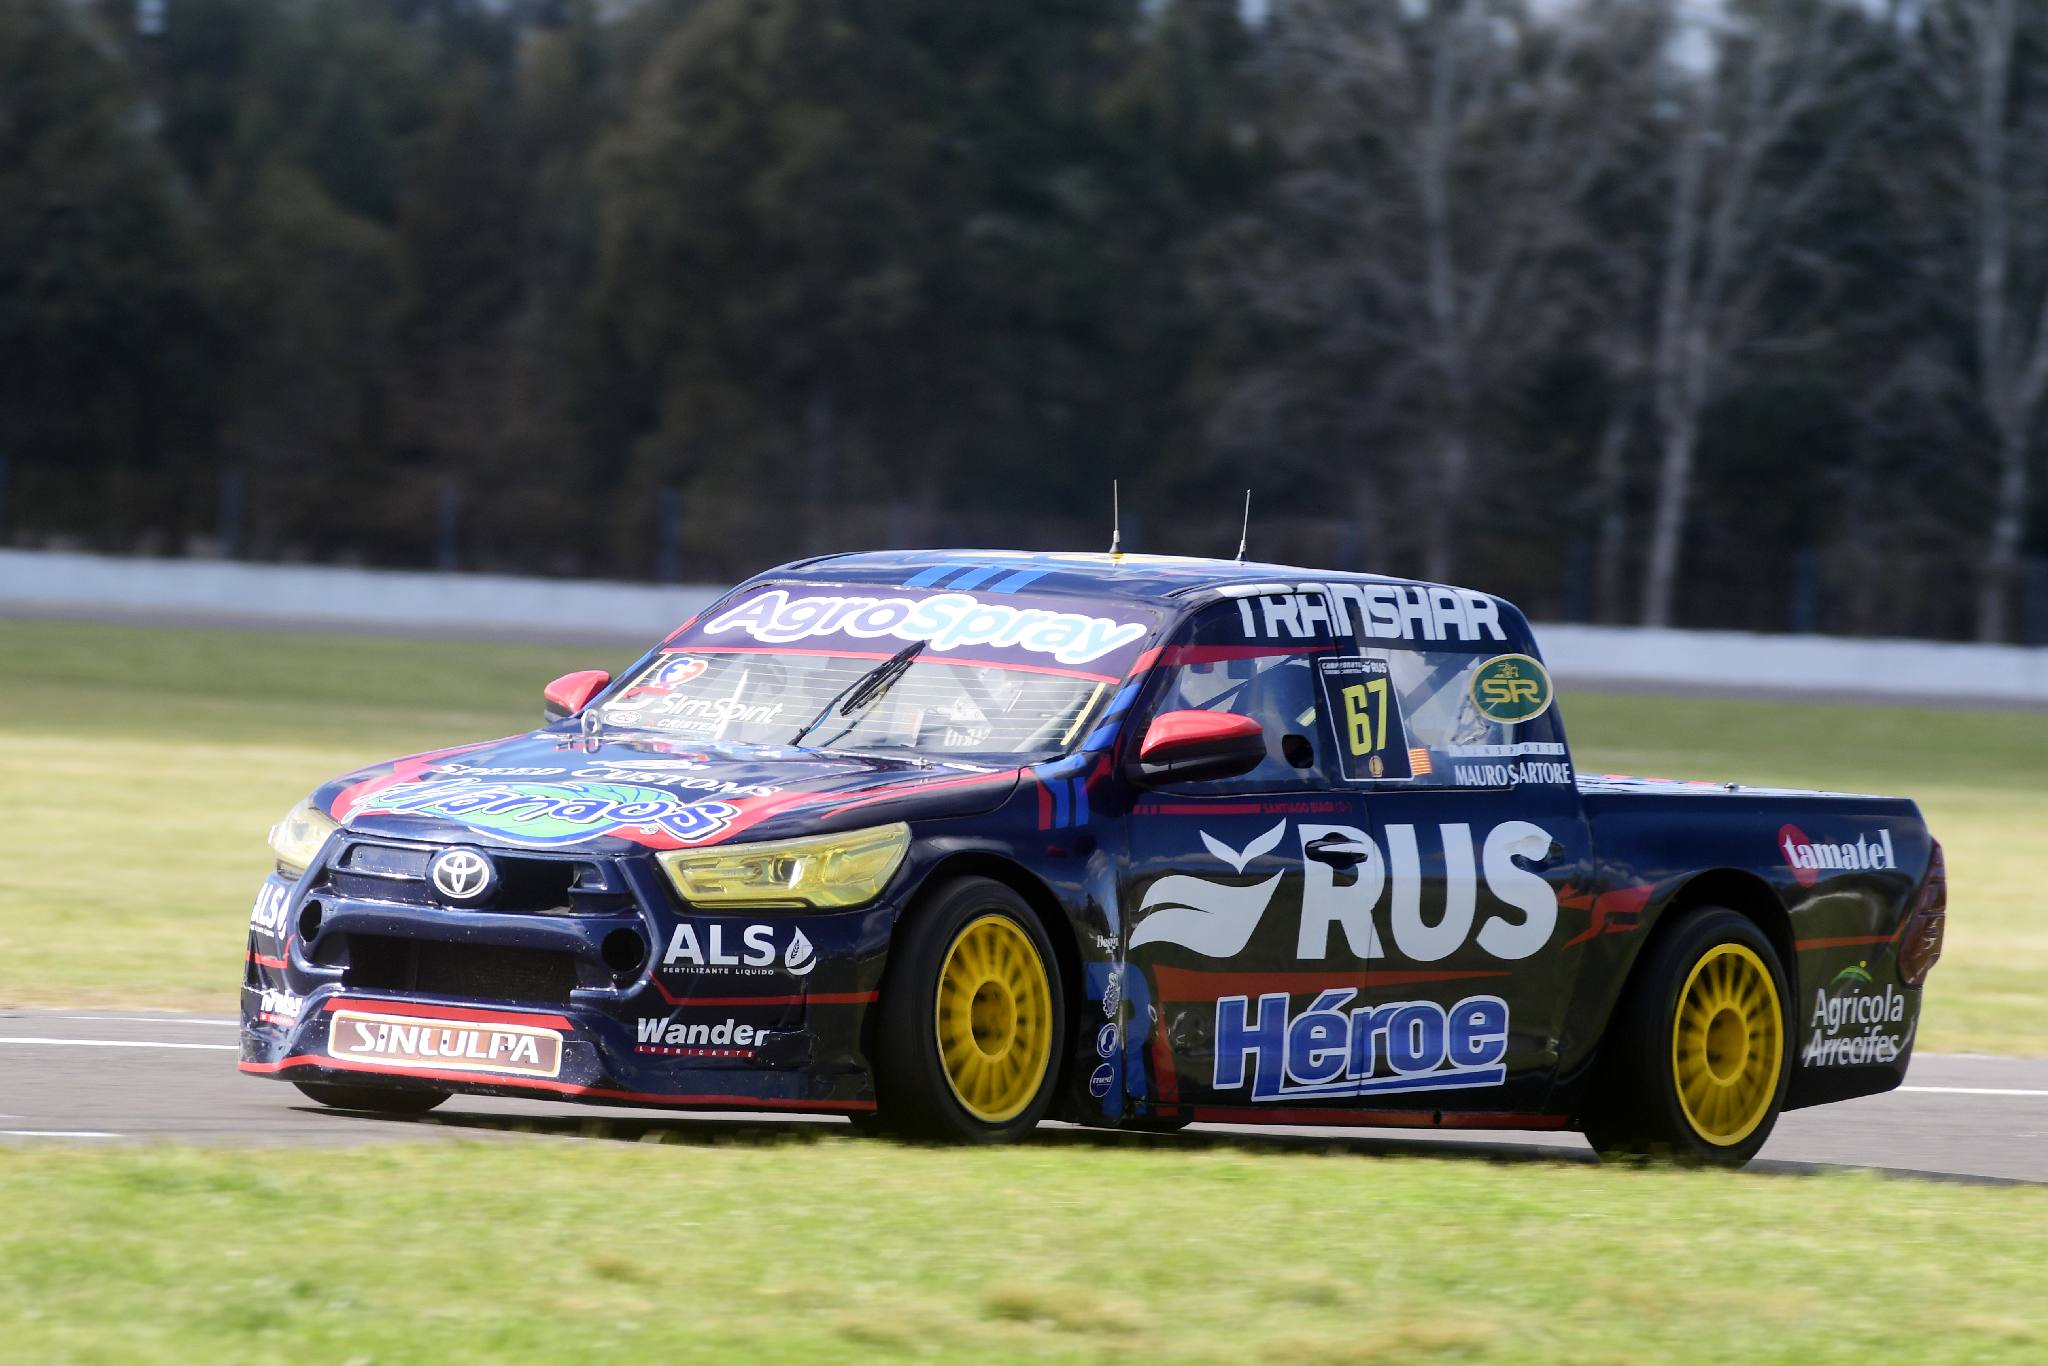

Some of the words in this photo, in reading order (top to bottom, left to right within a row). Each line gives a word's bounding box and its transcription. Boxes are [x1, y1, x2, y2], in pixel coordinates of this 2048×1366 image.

[703, 590, 1147, 665] AgroSpray
[1215, 583, 1508, 640] TRANSHAR
[1482, 678, 1541, 703] SR
[1342, 678, 1387, 756] 67
[1454, 764, 1507, 786] MAURO
[1508, 762, 1572, 786] SARTORE
[1783, 828, 1897, 870] tamatel
[1297, 820, 1558, 961] RUS
[662, 923, 776, 967] ALS
[663, 967, 729, 975] FERTILIZANTE
[735, 968, 774, 976] LIQUIDO
[637, 1016, 771, 1047] Wander
[1811, 983, 1905, 1036] Agricola
[1213, 987, 1510, 1102] Héroe
[1802, 1025, 1900, 1069] Arrecifes
